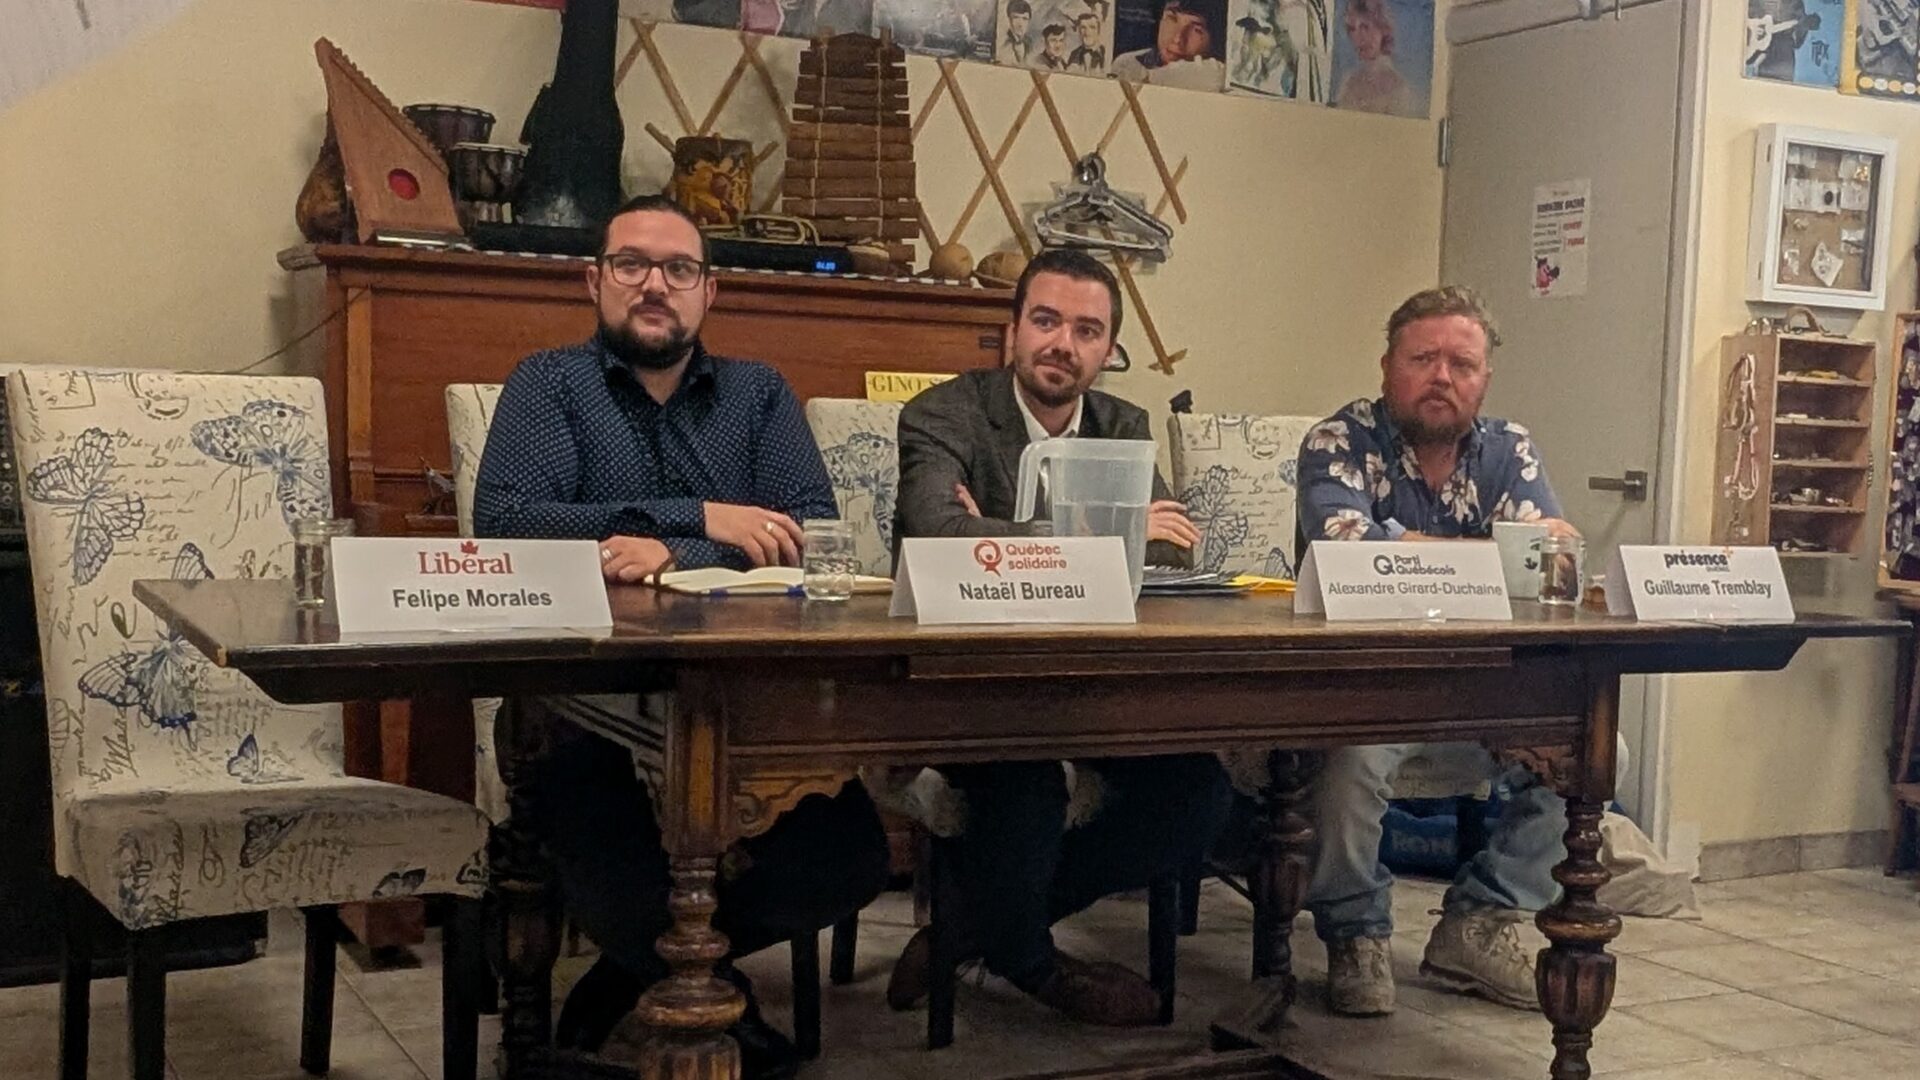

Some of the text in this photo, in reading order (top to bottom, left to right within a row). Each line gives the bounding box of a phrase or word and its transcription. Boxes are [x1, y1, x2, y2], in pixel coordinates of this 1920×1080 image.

[873, 375, 921, 393] GINO
[1005, 543, 1061, 556] Québec
[417, 551, 514, 575] Libéral
[1008, 556, 1067, 570] solidaire
[1394, 554, 1421, 565] Parti
[1664, 550, 1728, 568] présence
[1395, 563, 1456, 575] Québécois
[958, 582, 1085, 601] Nataël Bureau
[1328, 581, 1502, 597] Alexandre Girard-Duchaine
[1644, 579, 1772, 598] Guillaume Tremblay
[392, 588, 552, 611] Felipe Morales
